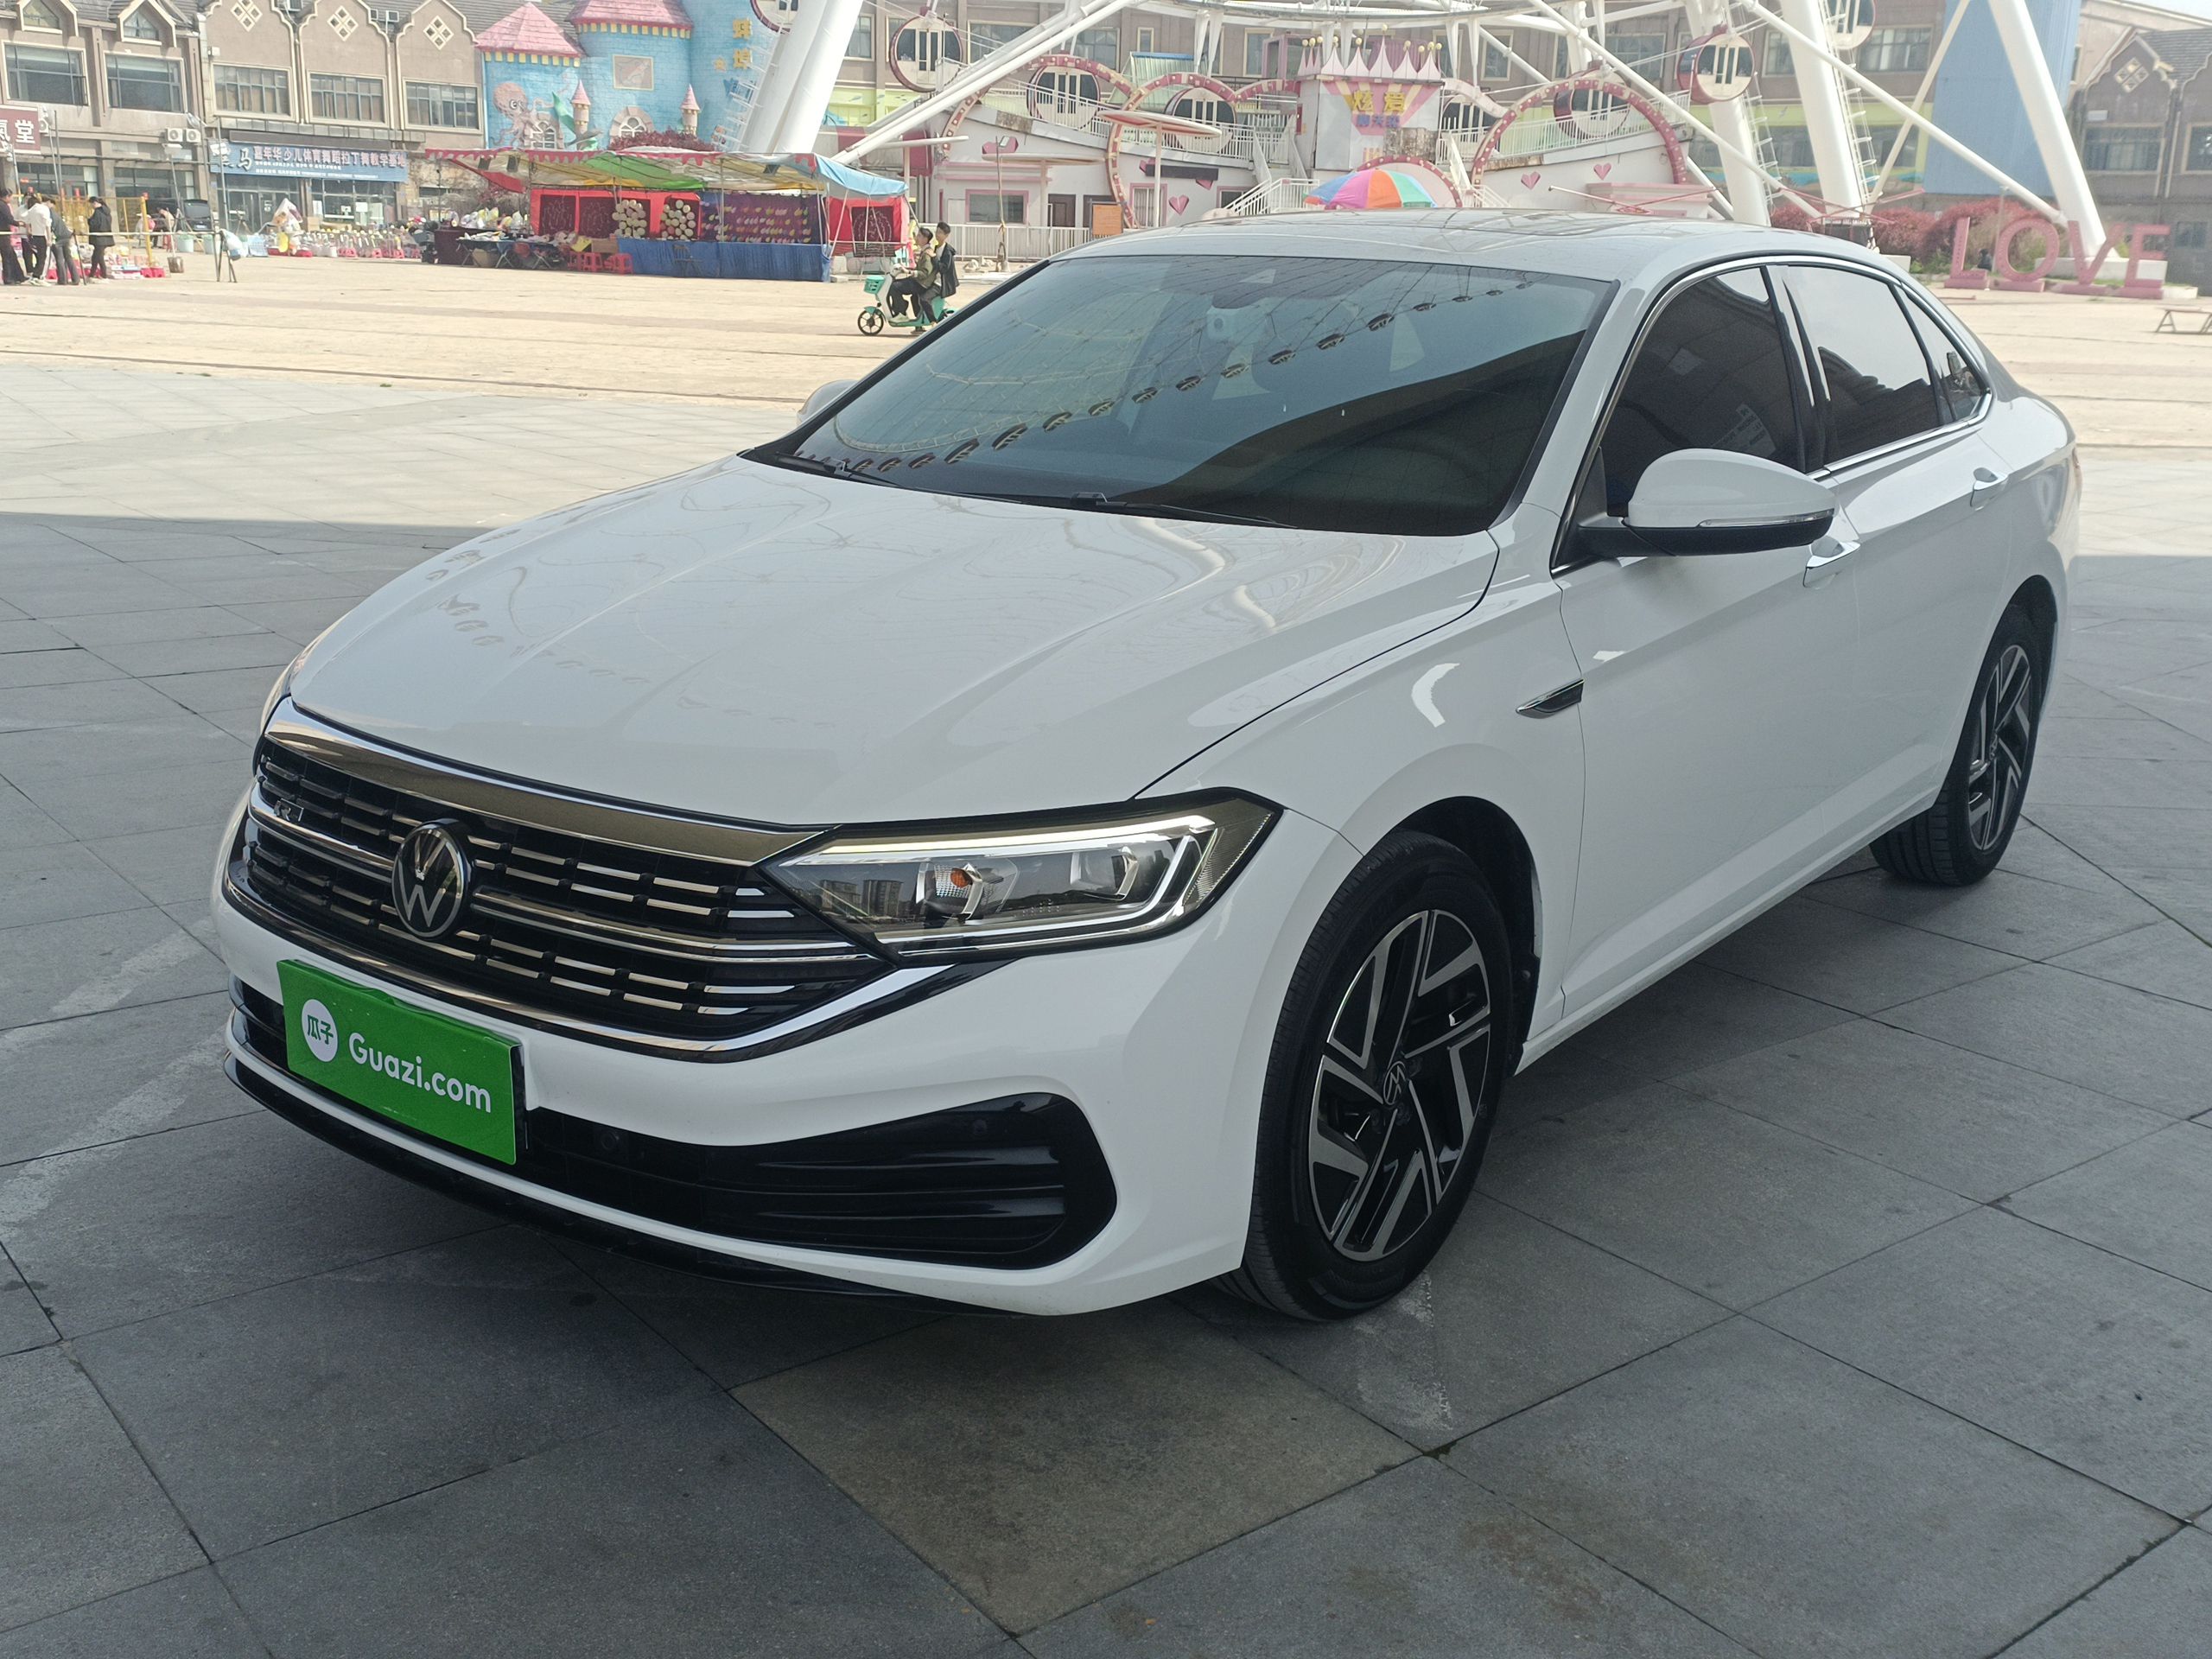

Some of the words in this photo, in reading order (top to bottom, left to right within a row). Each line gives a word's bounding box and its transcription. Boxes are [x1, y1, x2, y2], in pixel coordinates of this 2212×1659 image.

[1949, 216, 2171, 290] LOVE
[307, 1014, 334, 1045] 瓜子
[348, 1032, 492, 1114] Guazi.com
